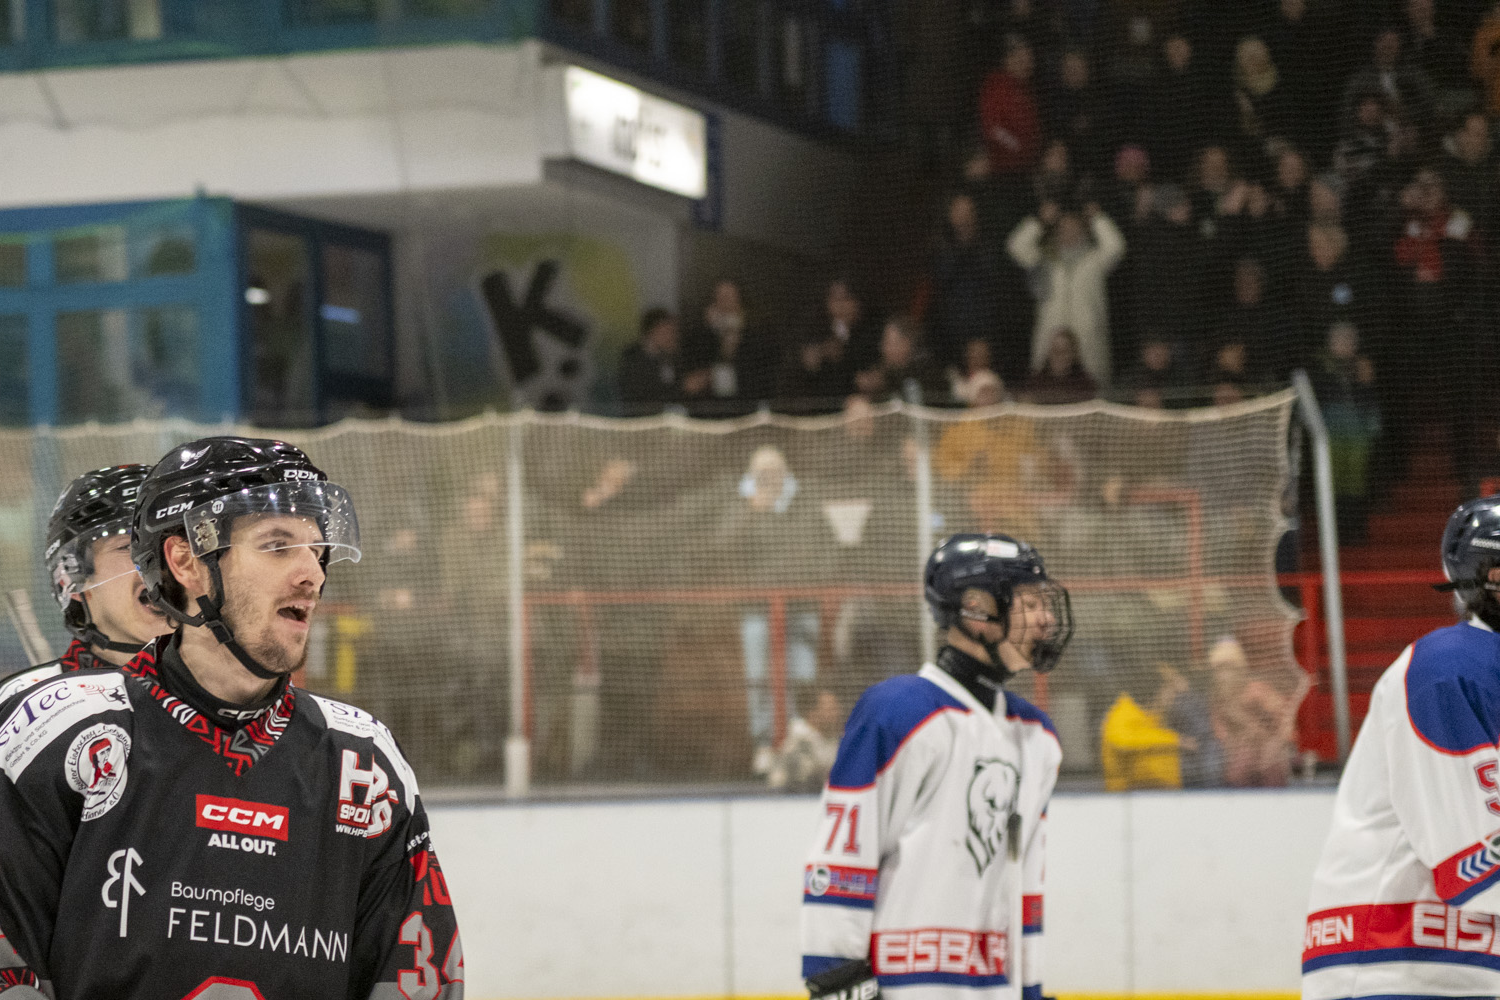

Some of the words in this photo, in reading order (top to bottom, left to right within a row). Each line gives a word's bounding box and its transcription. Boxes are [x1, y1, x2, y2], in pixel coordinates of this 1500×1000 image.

[155, 500, 196, 520] CCM
[201, 804, 285, 830] CCM
[826, 802, 860, 854] 71
[207, 833, 241, 850] ALL
[241, 837, 277, 857] OUT.
[171, 881, 276, 912] Baumpflege
[167, 907, 348, 963] FELDMANN
